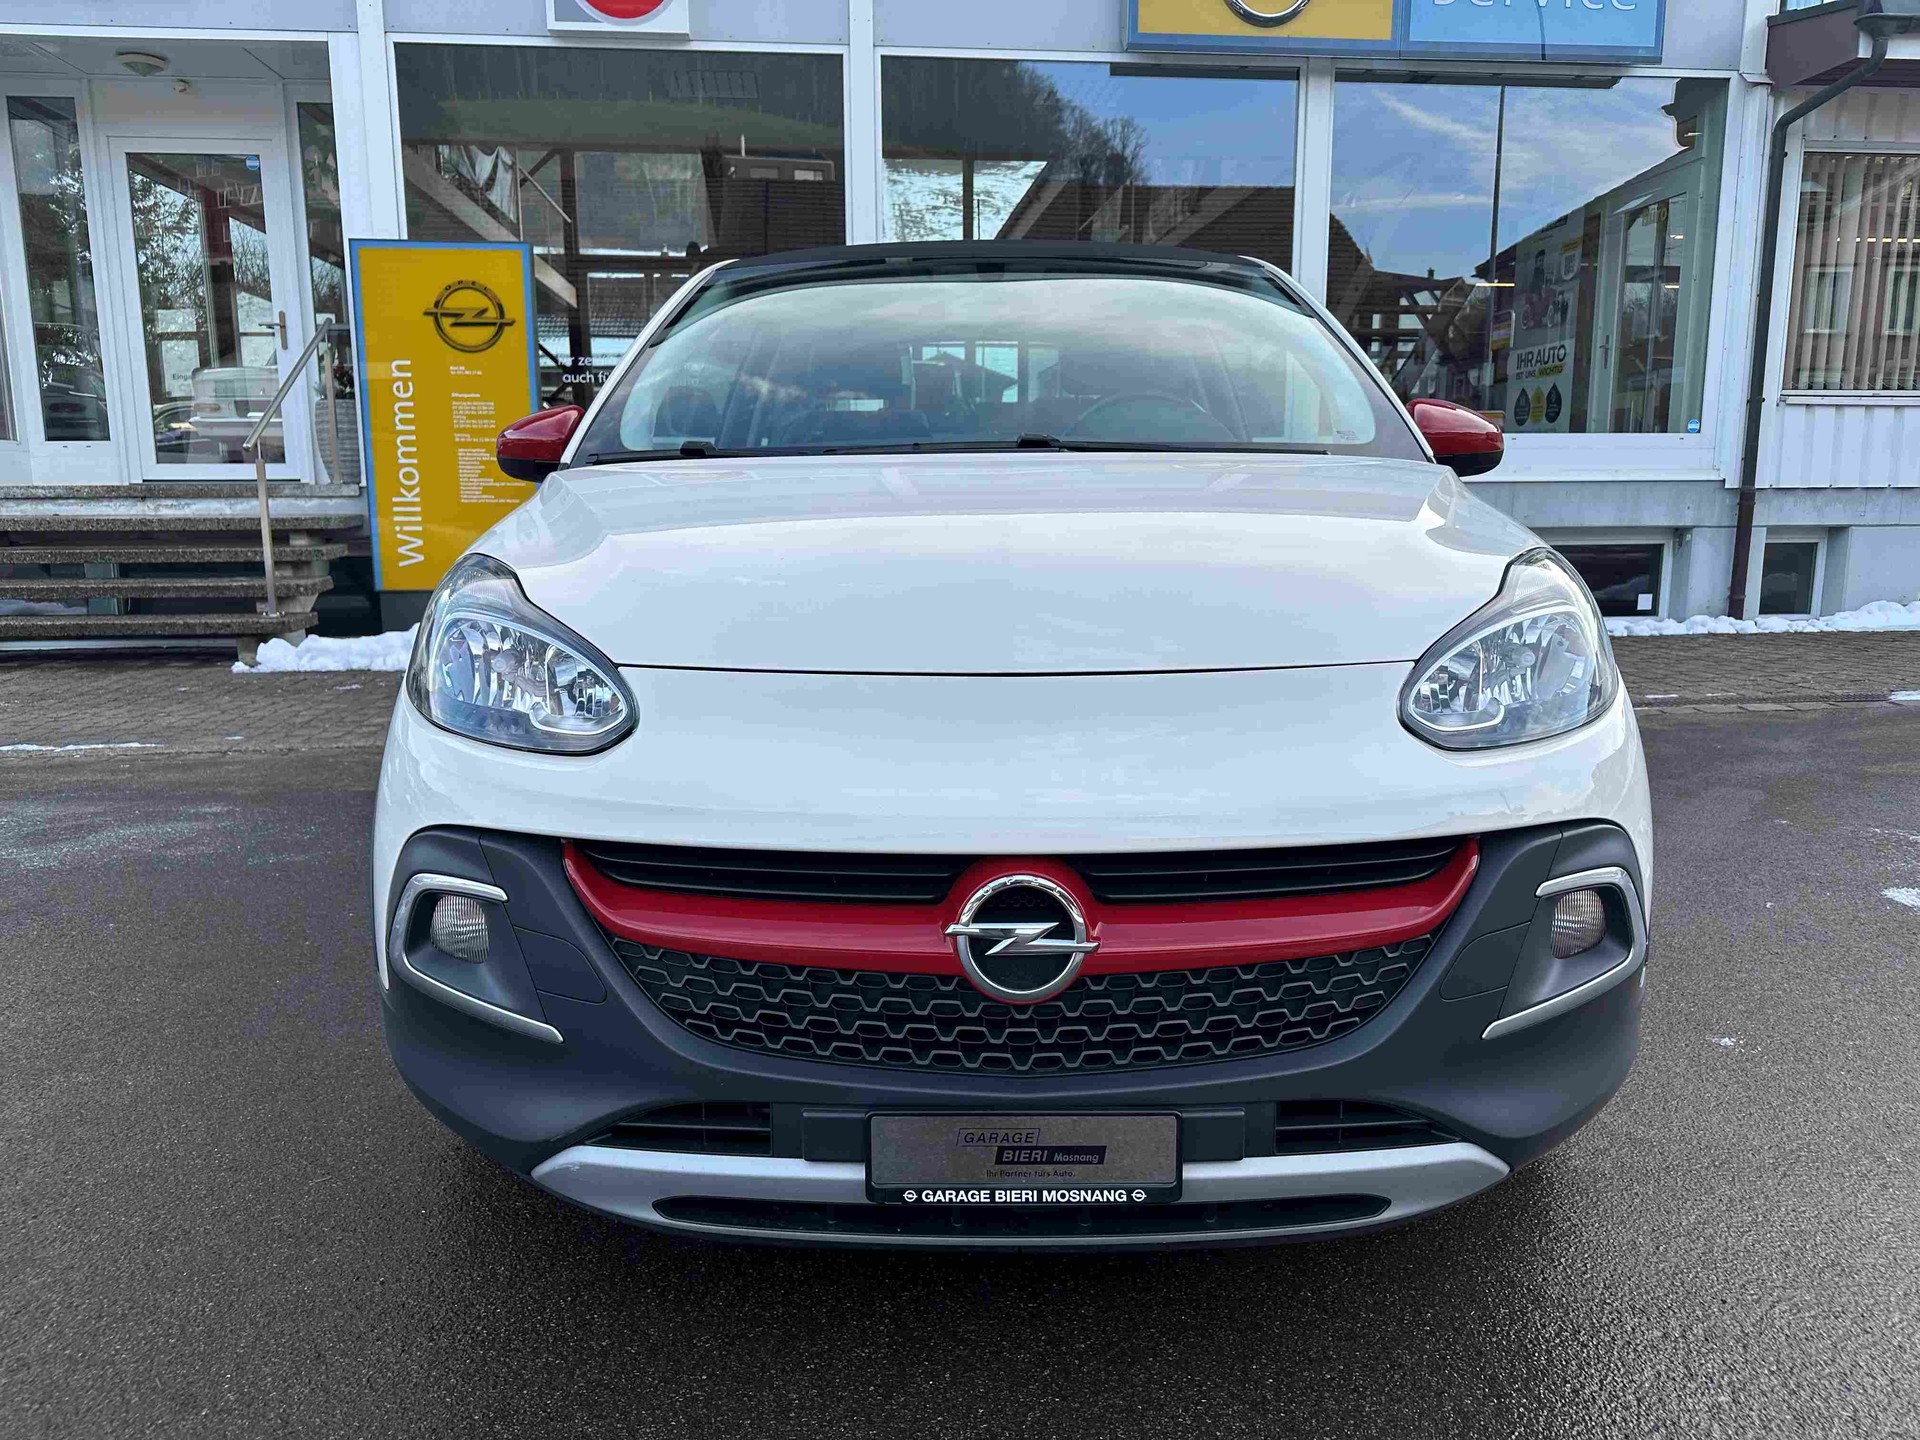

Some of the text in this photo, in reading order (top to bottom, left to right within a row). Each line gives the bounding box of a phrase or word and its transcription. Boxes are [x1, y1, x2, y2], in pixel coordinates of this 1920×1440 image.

[1516, 344, 1567, 371] IHR AUTO
[562, 370, 595, 384] auch
[1515, 371, 1525, 381] IST
[1525, 369, 1537, 379] UNS
[391, 359, 425, 567] Willkommen
[963, 1132, 1035, 1144] GARAGE
[1002, 1150, 1099, 1164] BIERI Mosnang
[986, 1169, 997, 1177] Ihr
[1000, 1169, 1032, 1178] Partner
[921, 1189, 1128, 1203] GARAGE BIERI MOSNANG
